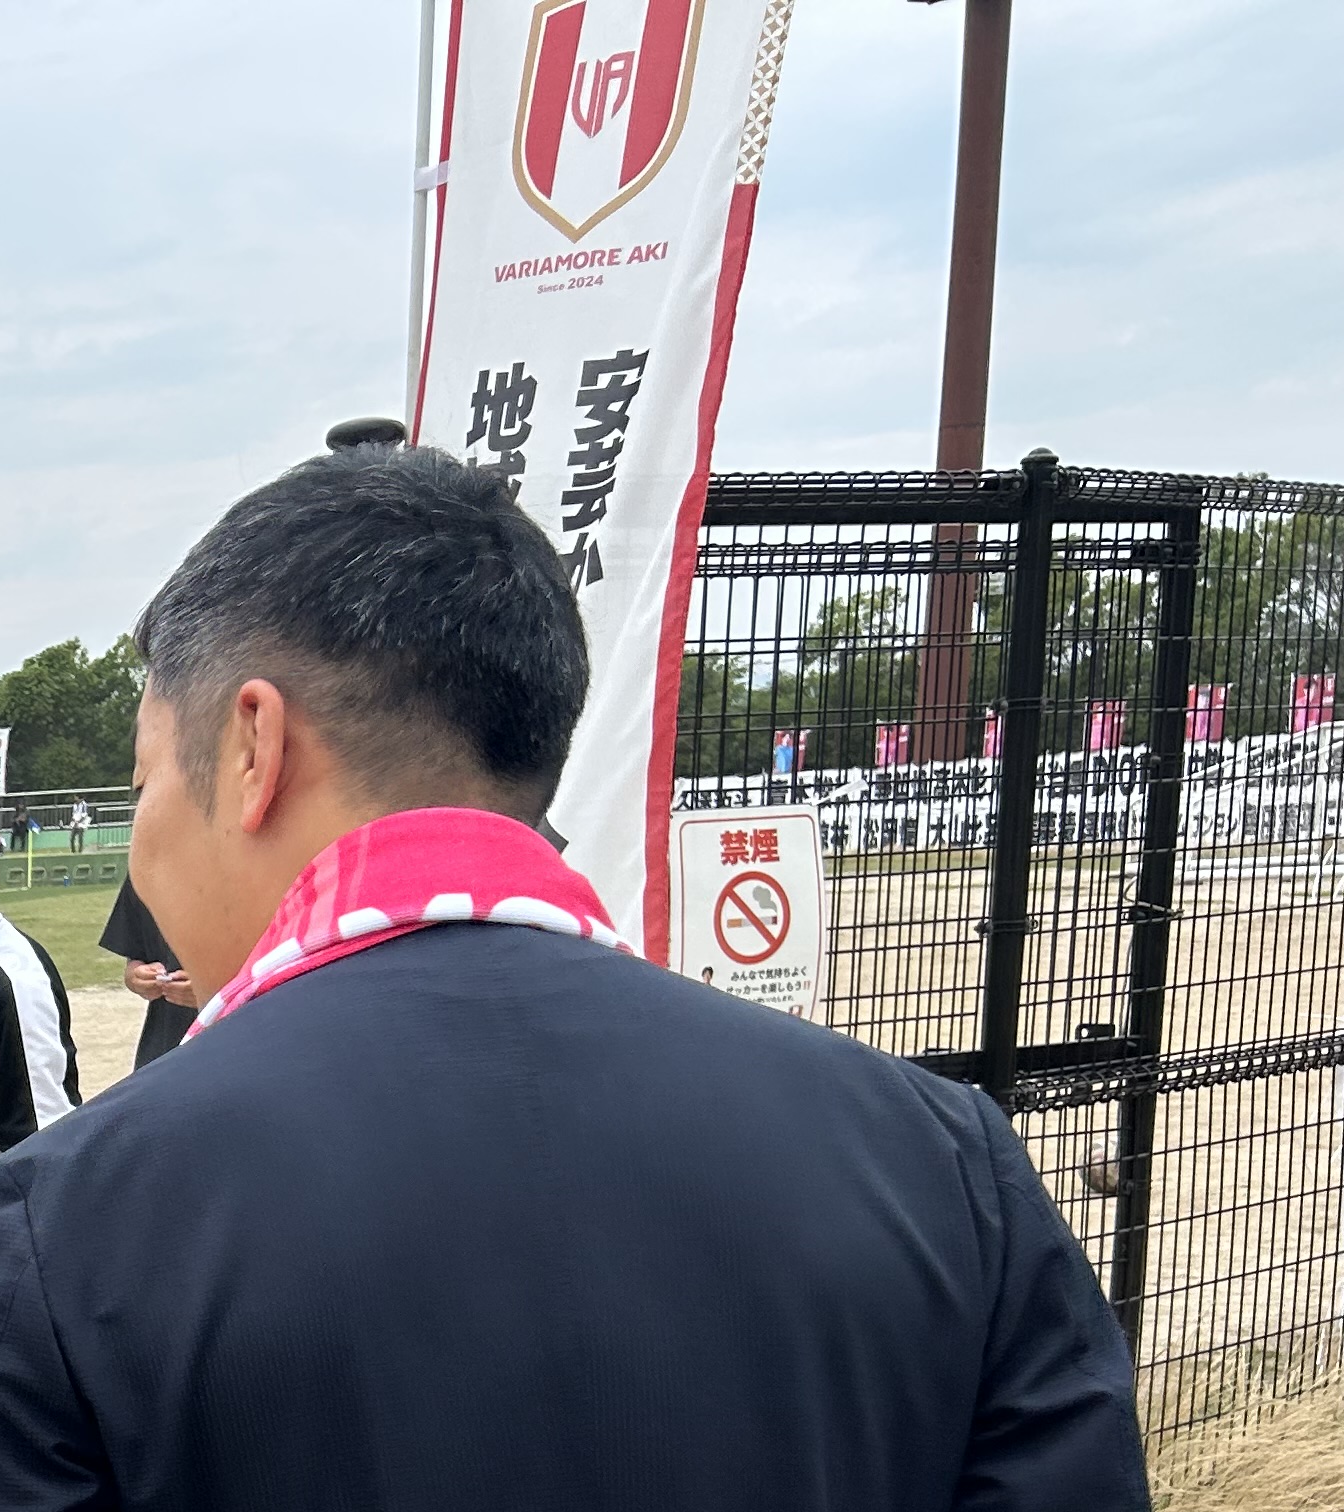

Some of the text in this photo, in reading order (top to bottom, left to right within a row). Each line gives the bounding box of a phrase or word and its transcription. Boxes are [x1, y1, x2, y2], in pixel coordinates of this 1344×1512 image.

[495, 241, 669, 283] VARIAMORE AKI
[537, 274, 604, 294] Since 2024
[720, 828, 780, 866] 禁煙
